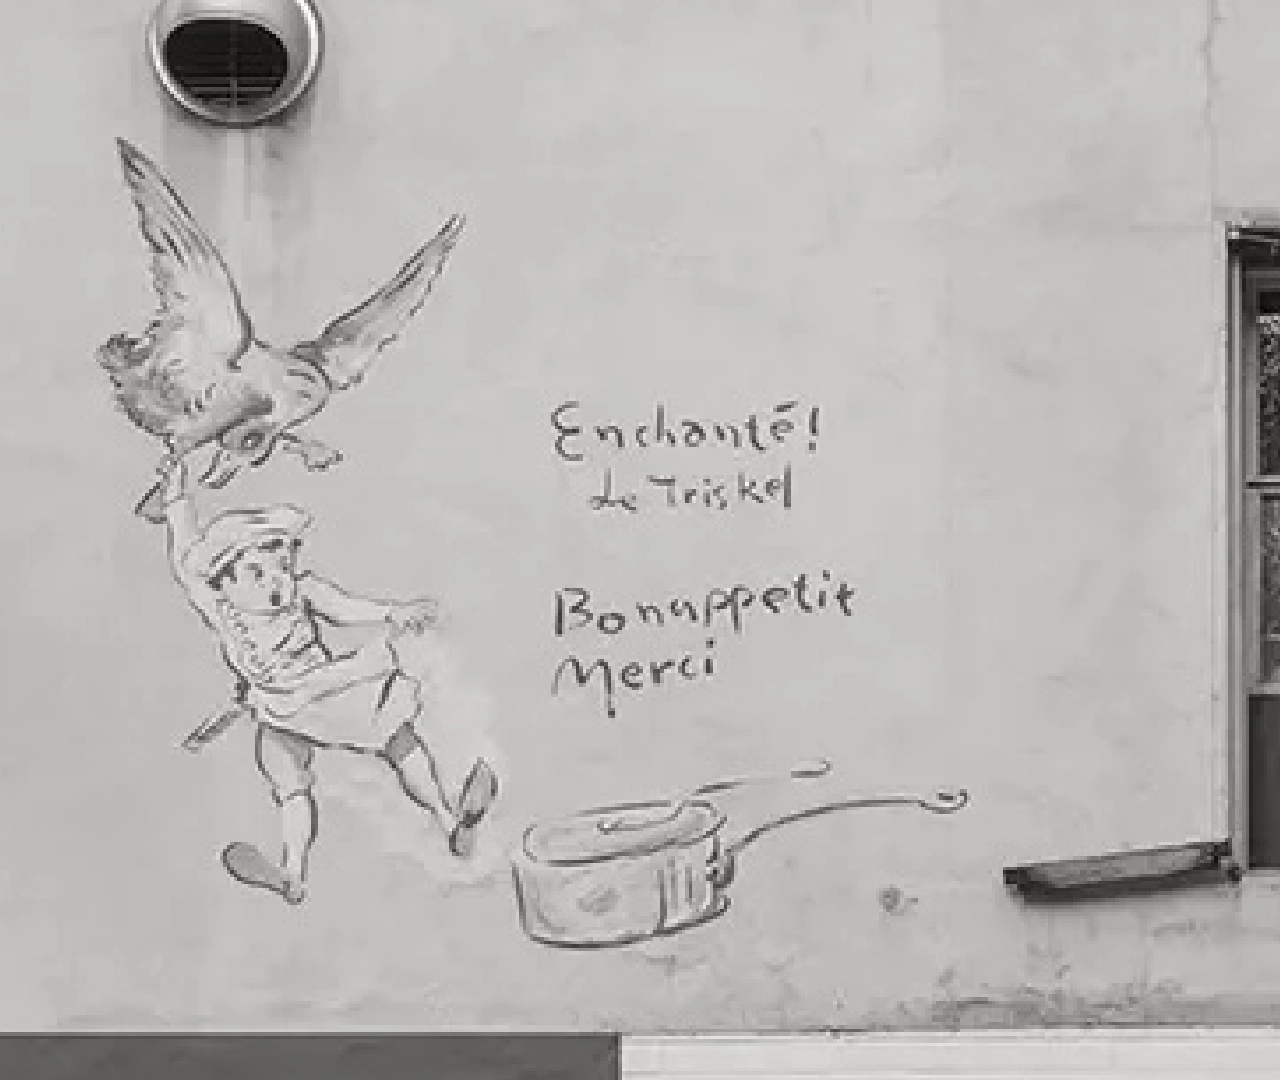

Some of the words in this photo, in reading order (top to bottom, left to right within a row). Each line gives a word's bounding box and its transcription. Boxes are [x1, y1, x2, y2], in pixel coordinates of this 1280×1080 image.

[550, 400, 821, 462] Enchanté!
[588, 467, 638, 513] Le
[646, 462, 792, 512] Triskel
[550, 635, 716, 719] Merci
